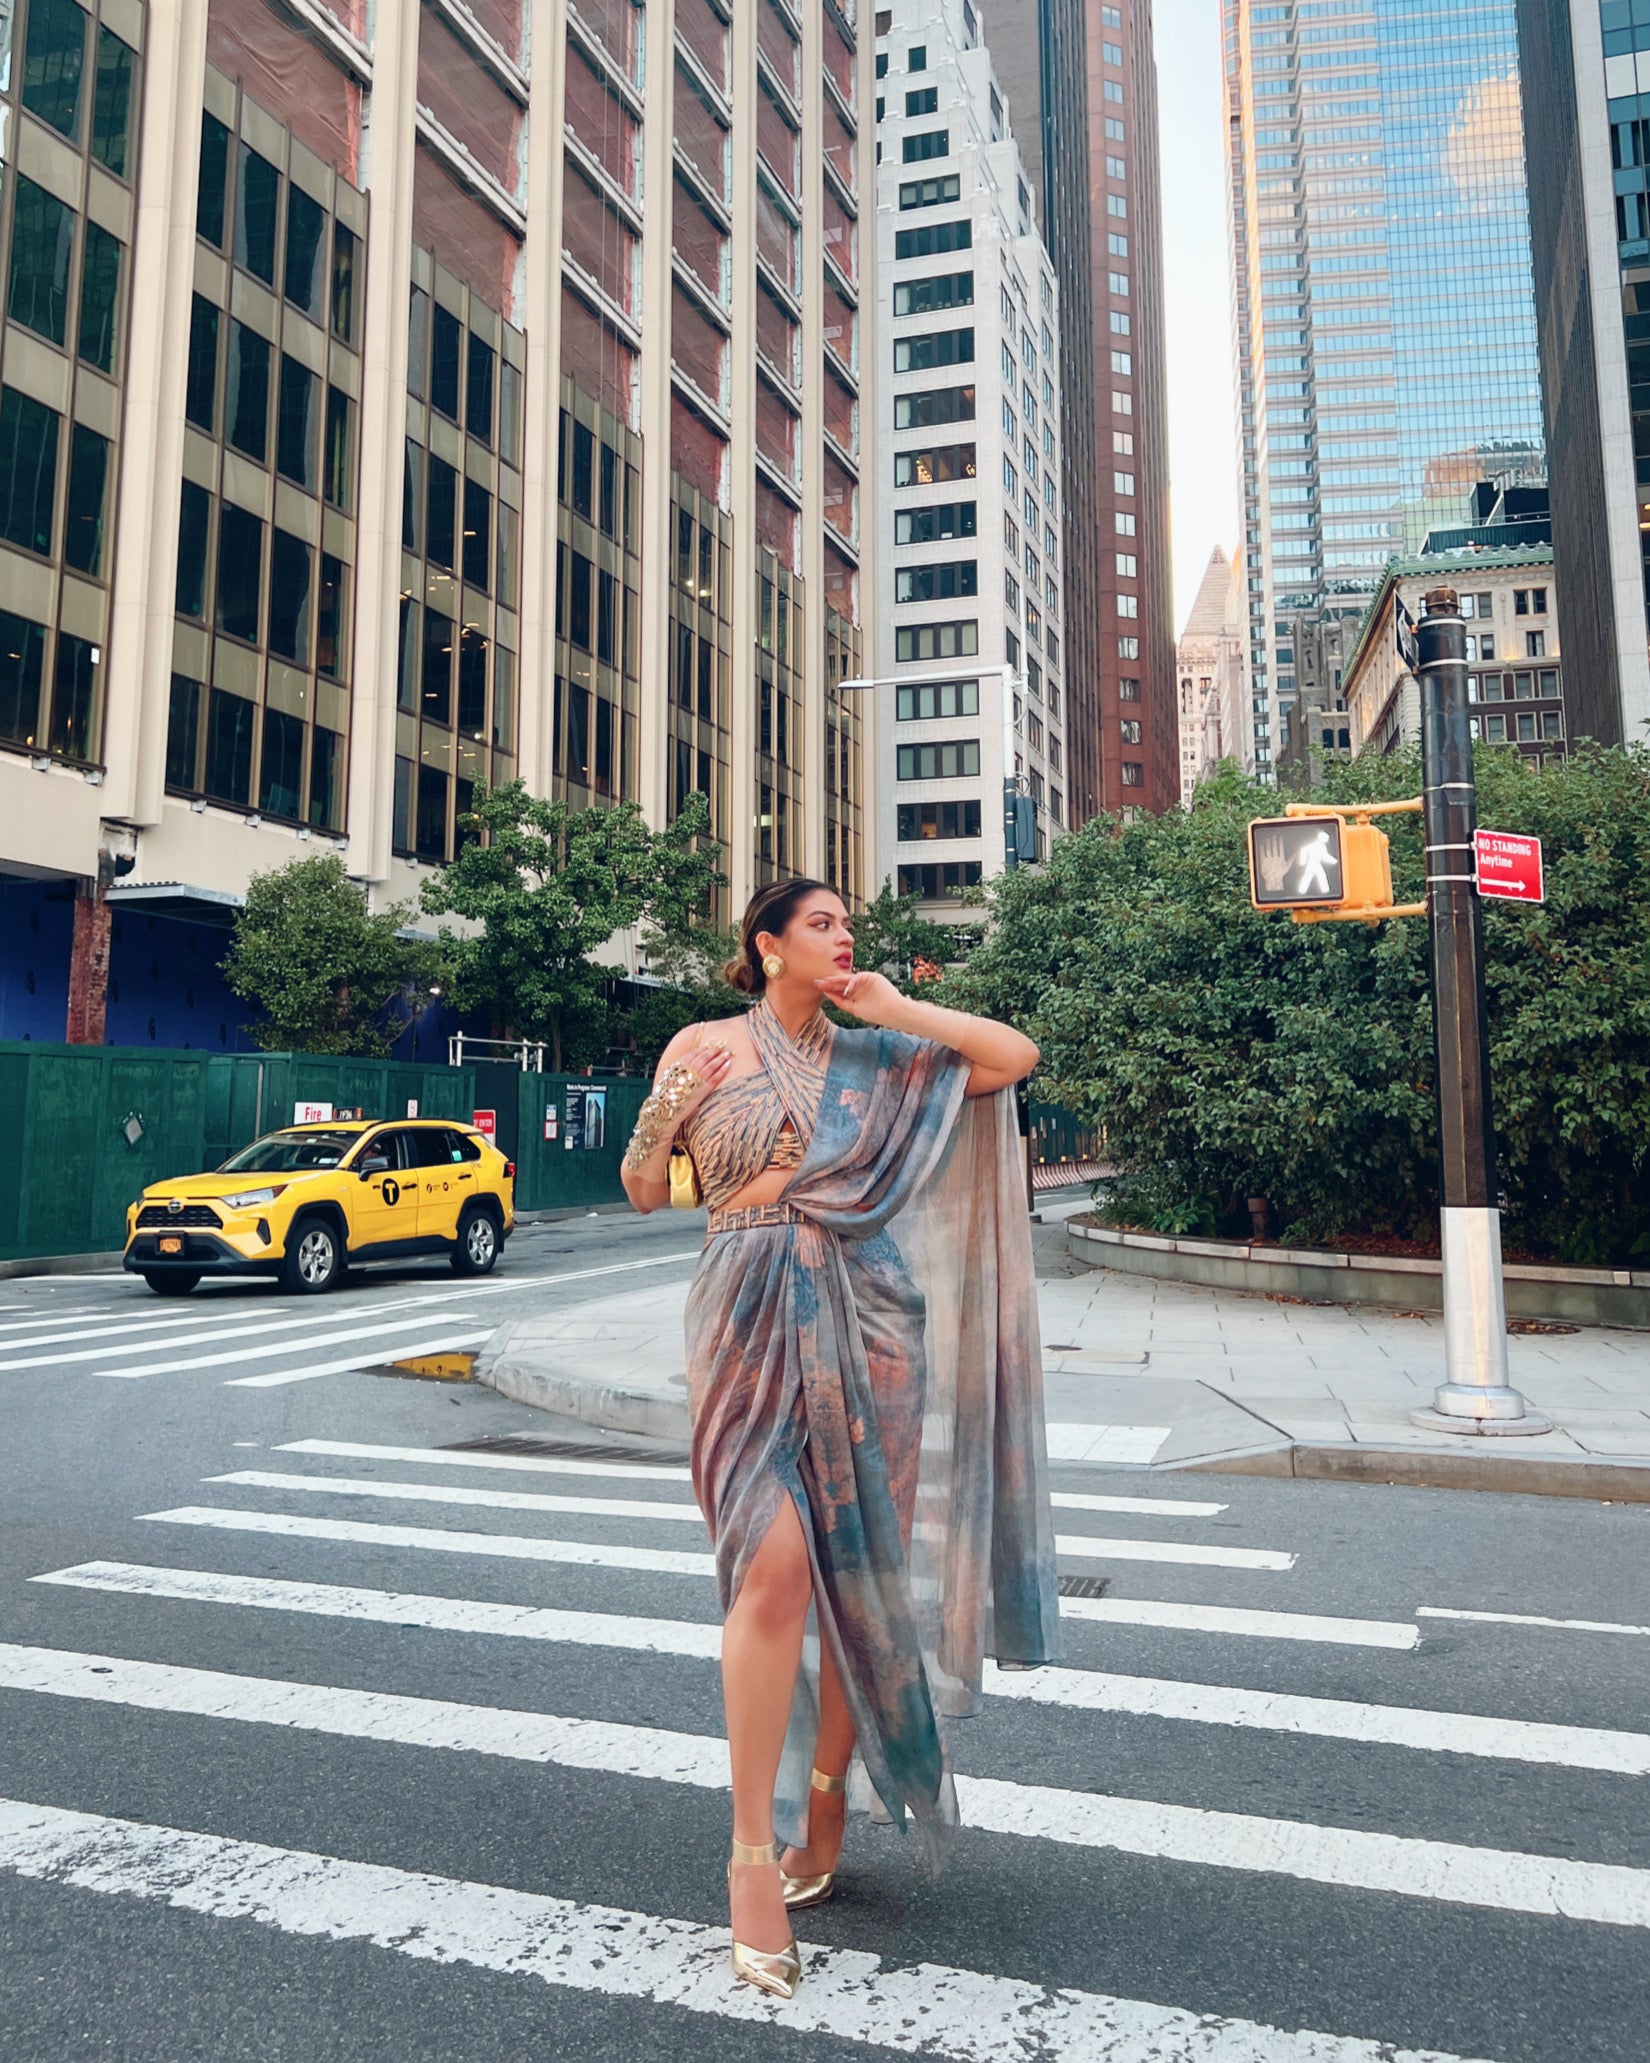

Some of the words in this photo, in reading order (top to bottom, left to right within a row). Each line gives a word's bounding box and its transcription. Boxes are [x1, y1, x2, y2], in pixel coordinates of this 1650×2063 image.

[1478, 838, 1491, 850] NO
[1492, 840, 1532, 856] STANDING
[1480, 852, 1513, 868] Anytime
[305, 1106, 322, 1121] Fire
